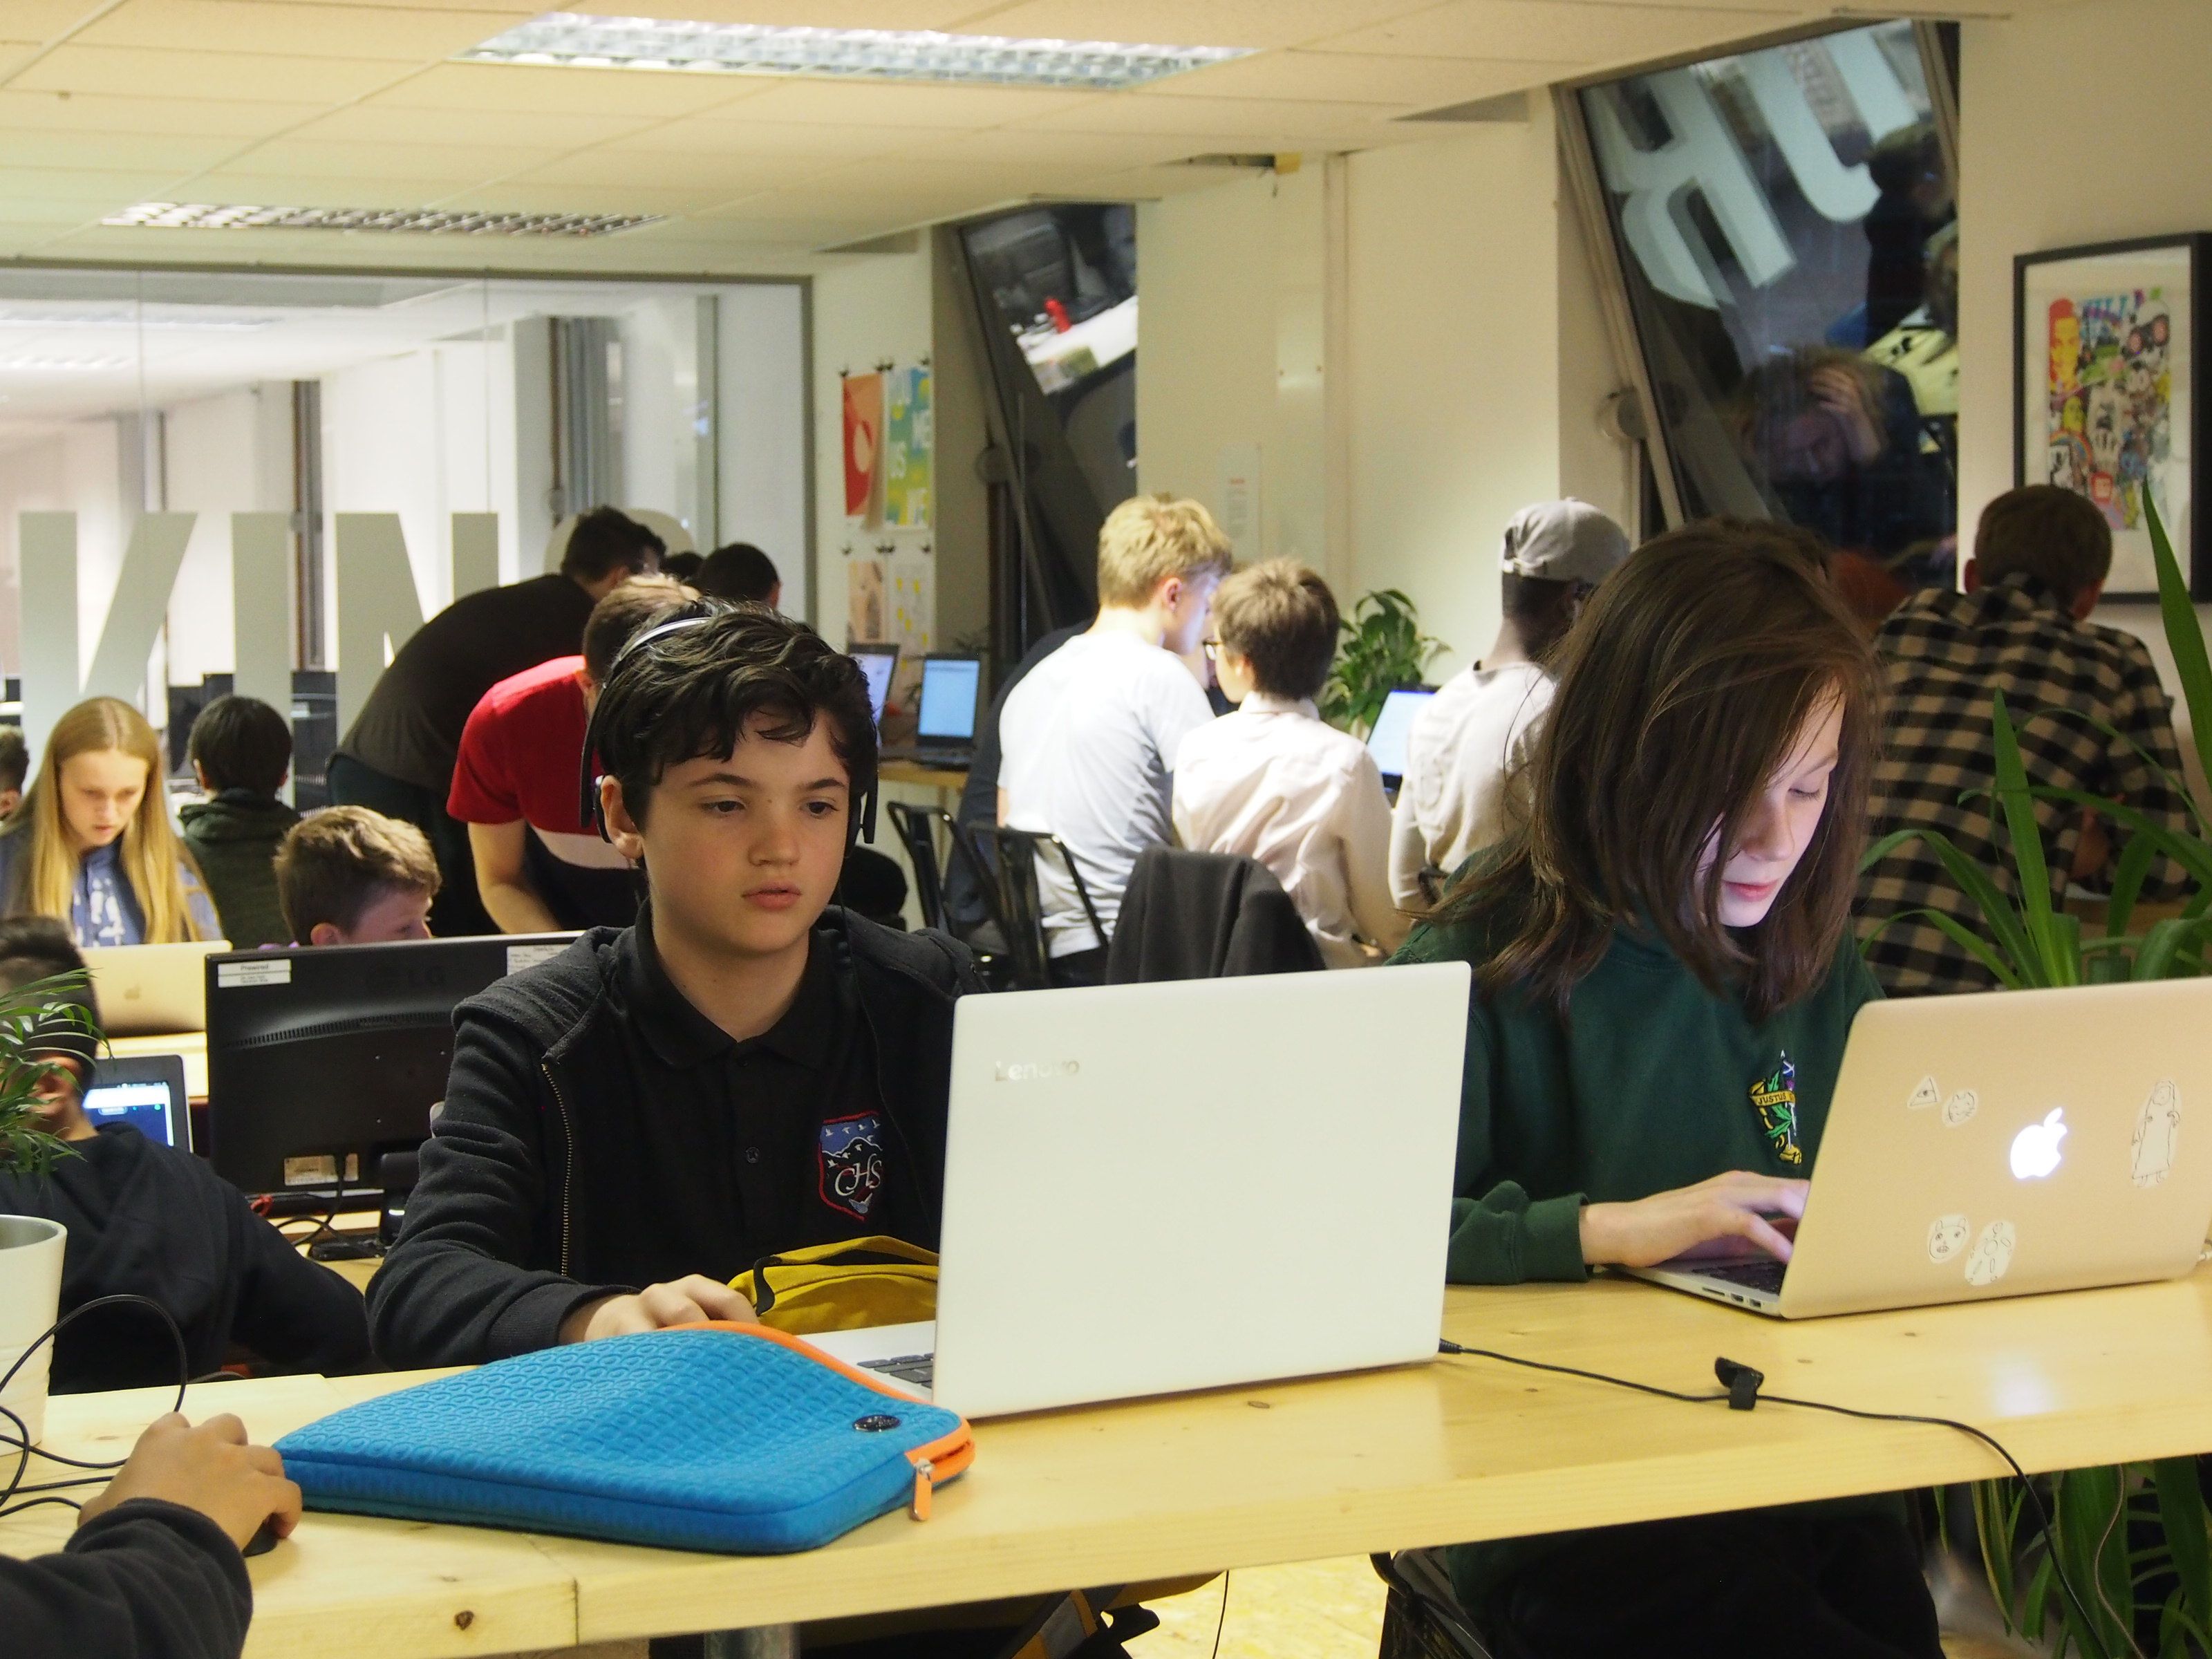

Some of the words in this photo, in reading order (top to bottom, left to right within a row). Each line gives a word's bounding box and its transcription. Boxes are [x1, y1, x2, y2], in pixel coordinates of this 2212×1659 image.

[995, 1060, 1080, 1081] Lenovo
[1758, 1093, 1787, 1104] JUSTUS
[835, 1153, 882, 1197] CHS
